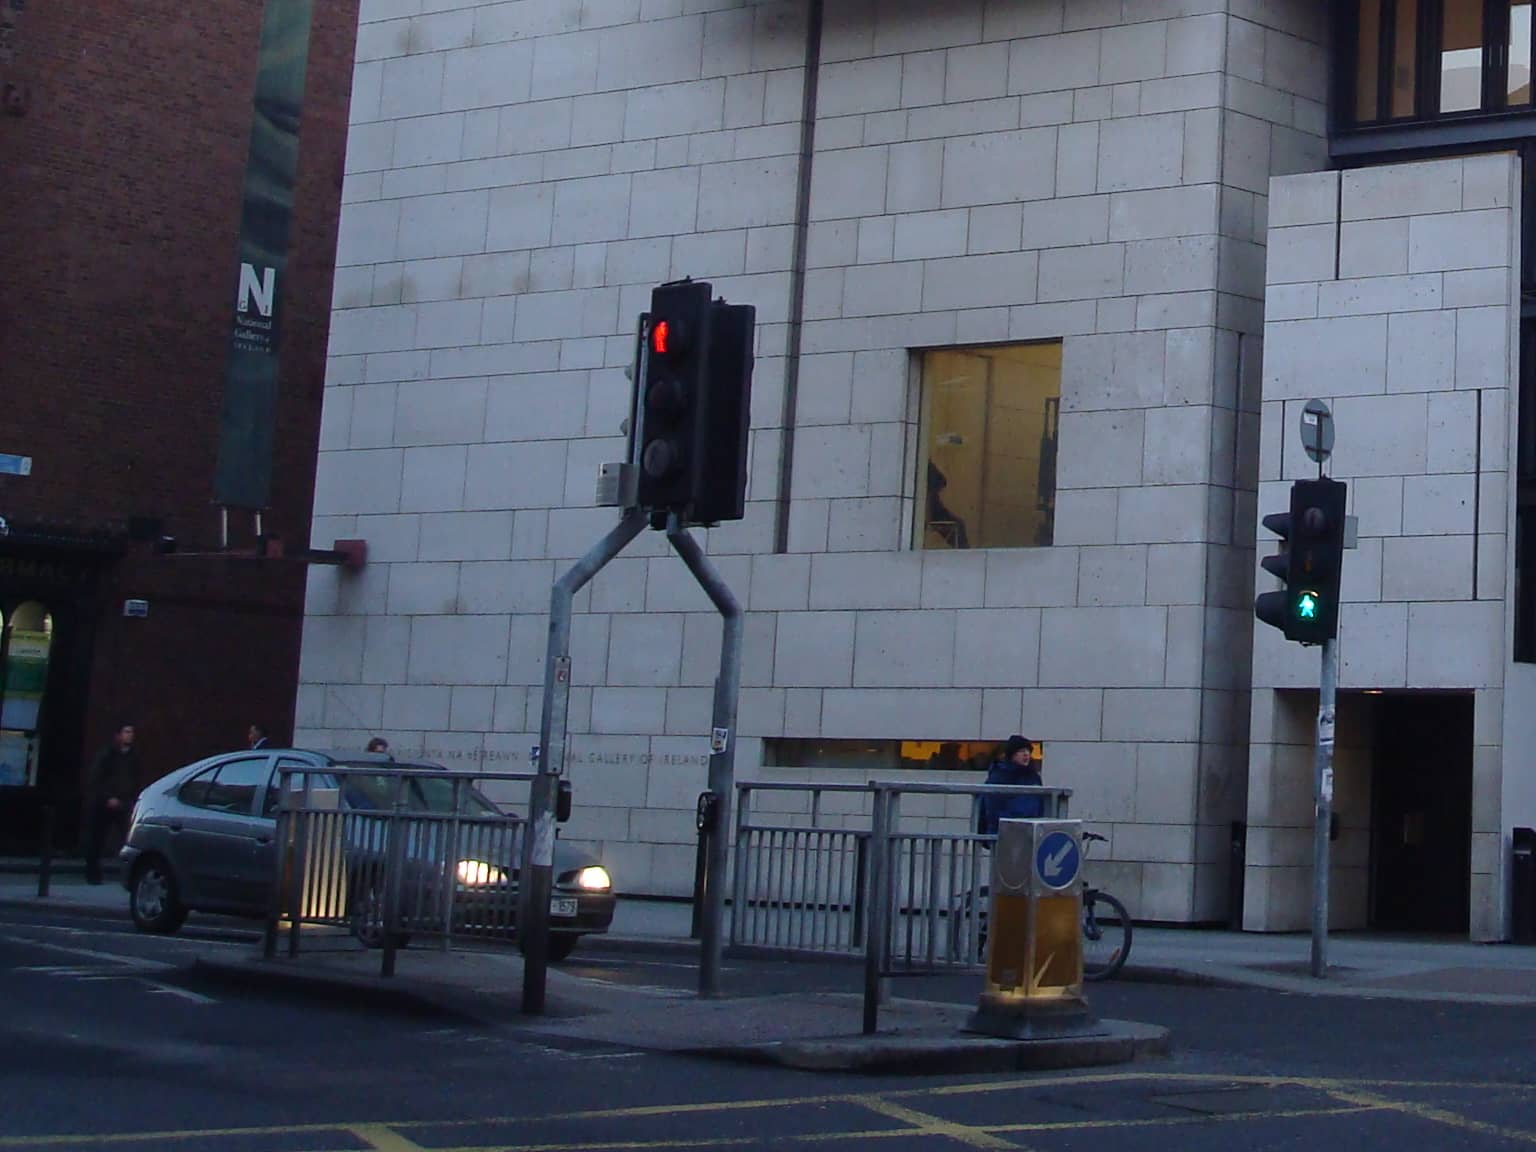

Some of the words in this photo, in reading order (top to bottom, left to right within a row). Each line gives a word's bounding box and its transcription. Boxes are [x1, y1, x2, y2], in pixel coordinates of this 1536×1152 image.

[237, 263, 276, 317] N
[236, 315, 272, 330] National
[234, 328, 263, 345] Gallery
[588, 751, 635, 765] GALLERY
[639, 752, 654, 765] OF
[660, 753, 709, 766] IRELAND
